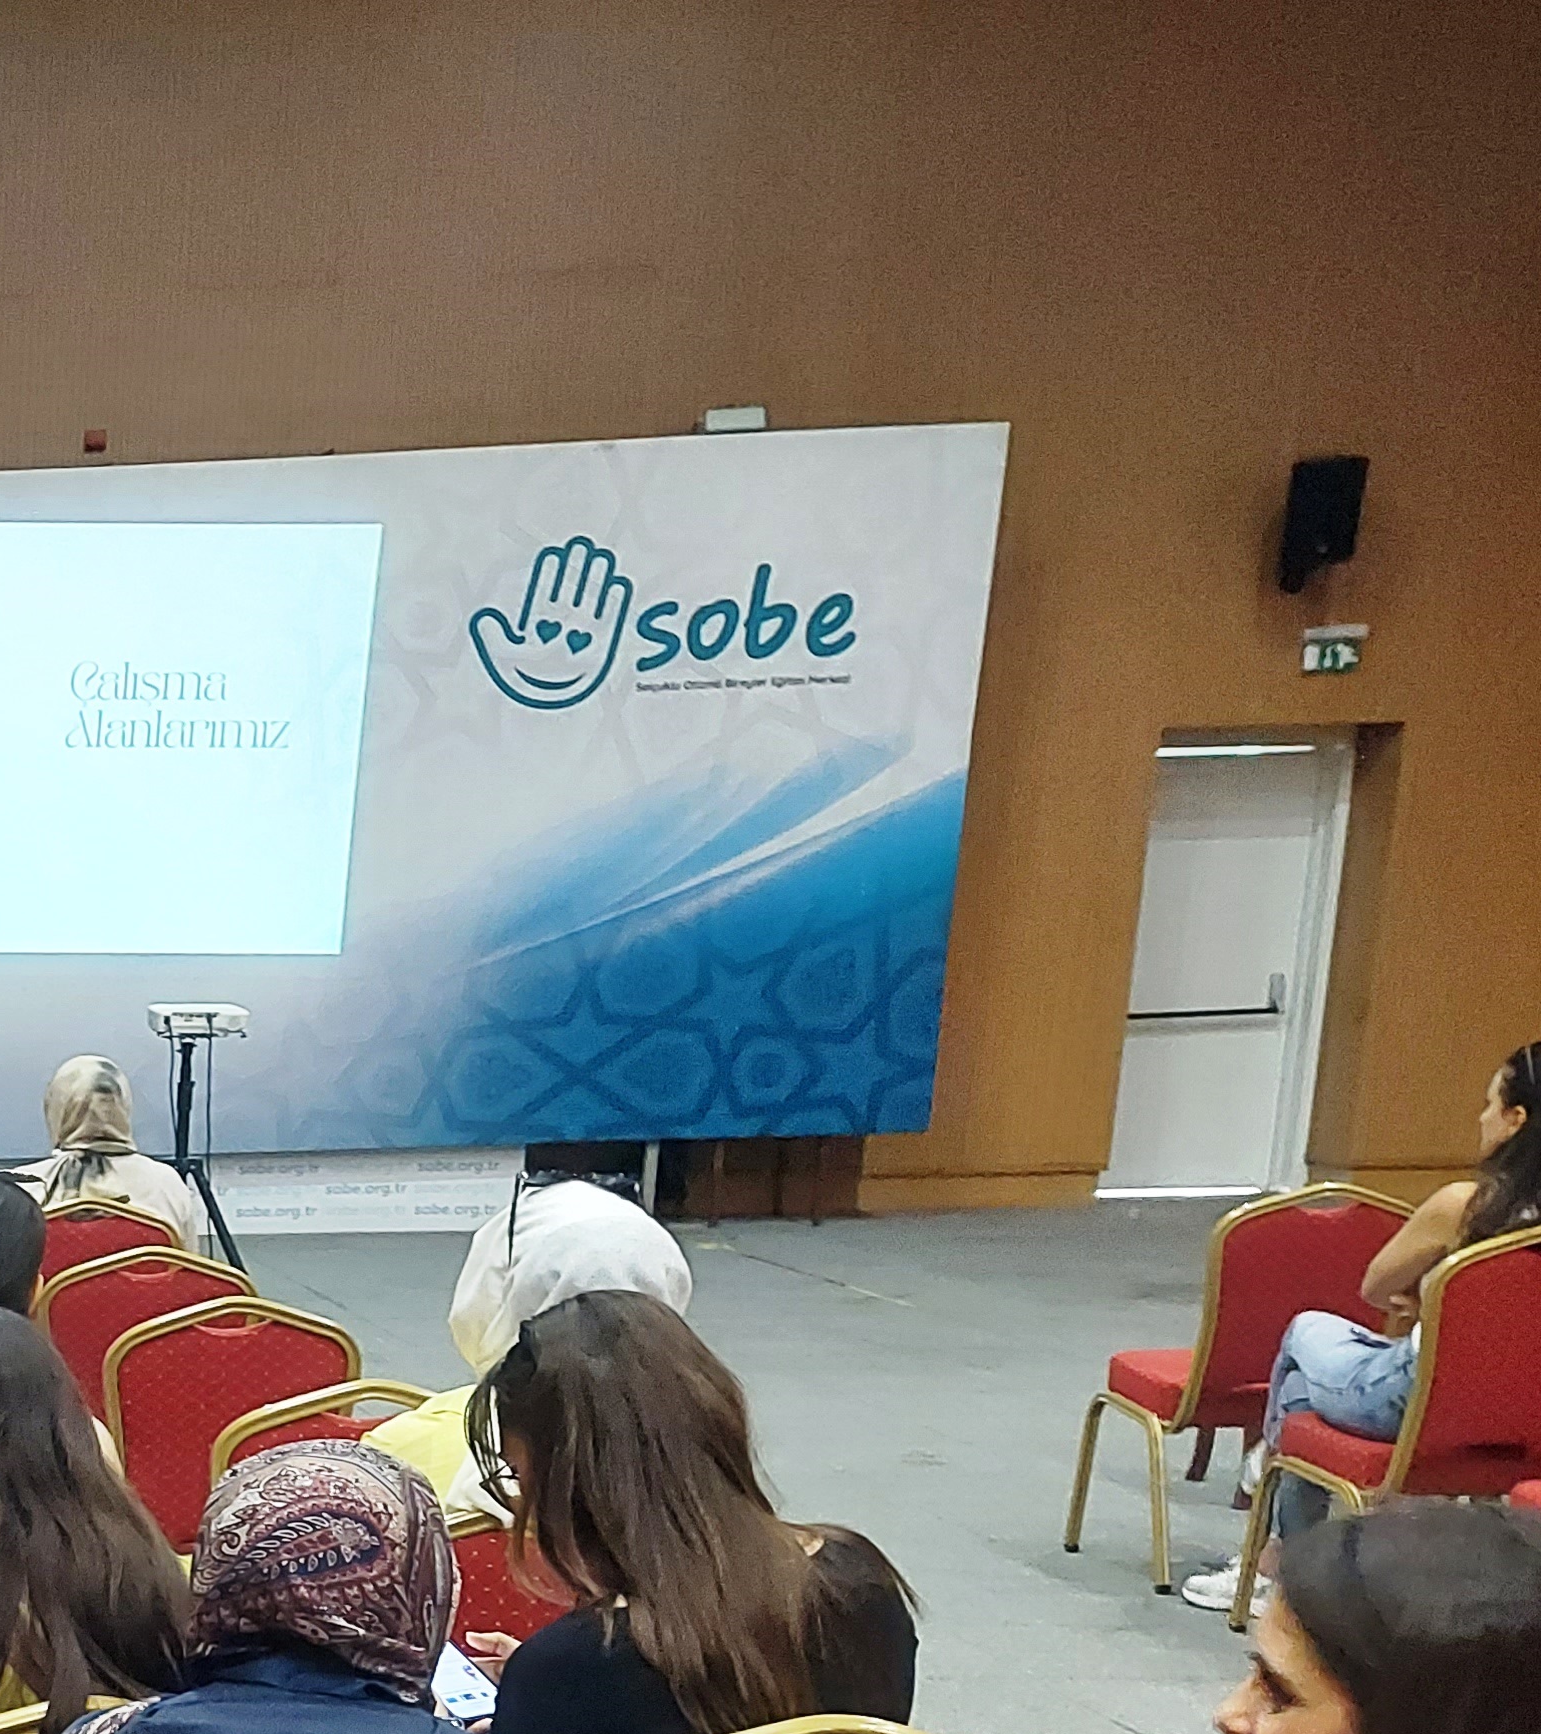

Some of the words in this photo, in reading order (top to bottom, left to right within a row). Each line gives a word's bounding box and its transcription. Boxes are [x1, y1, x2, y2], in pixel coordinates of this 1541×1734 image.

[636, 562, 857, 672] sobe
[70, 660, 227, 707] Çalışma
[64, 709, 291, 749] Alanlarımız
